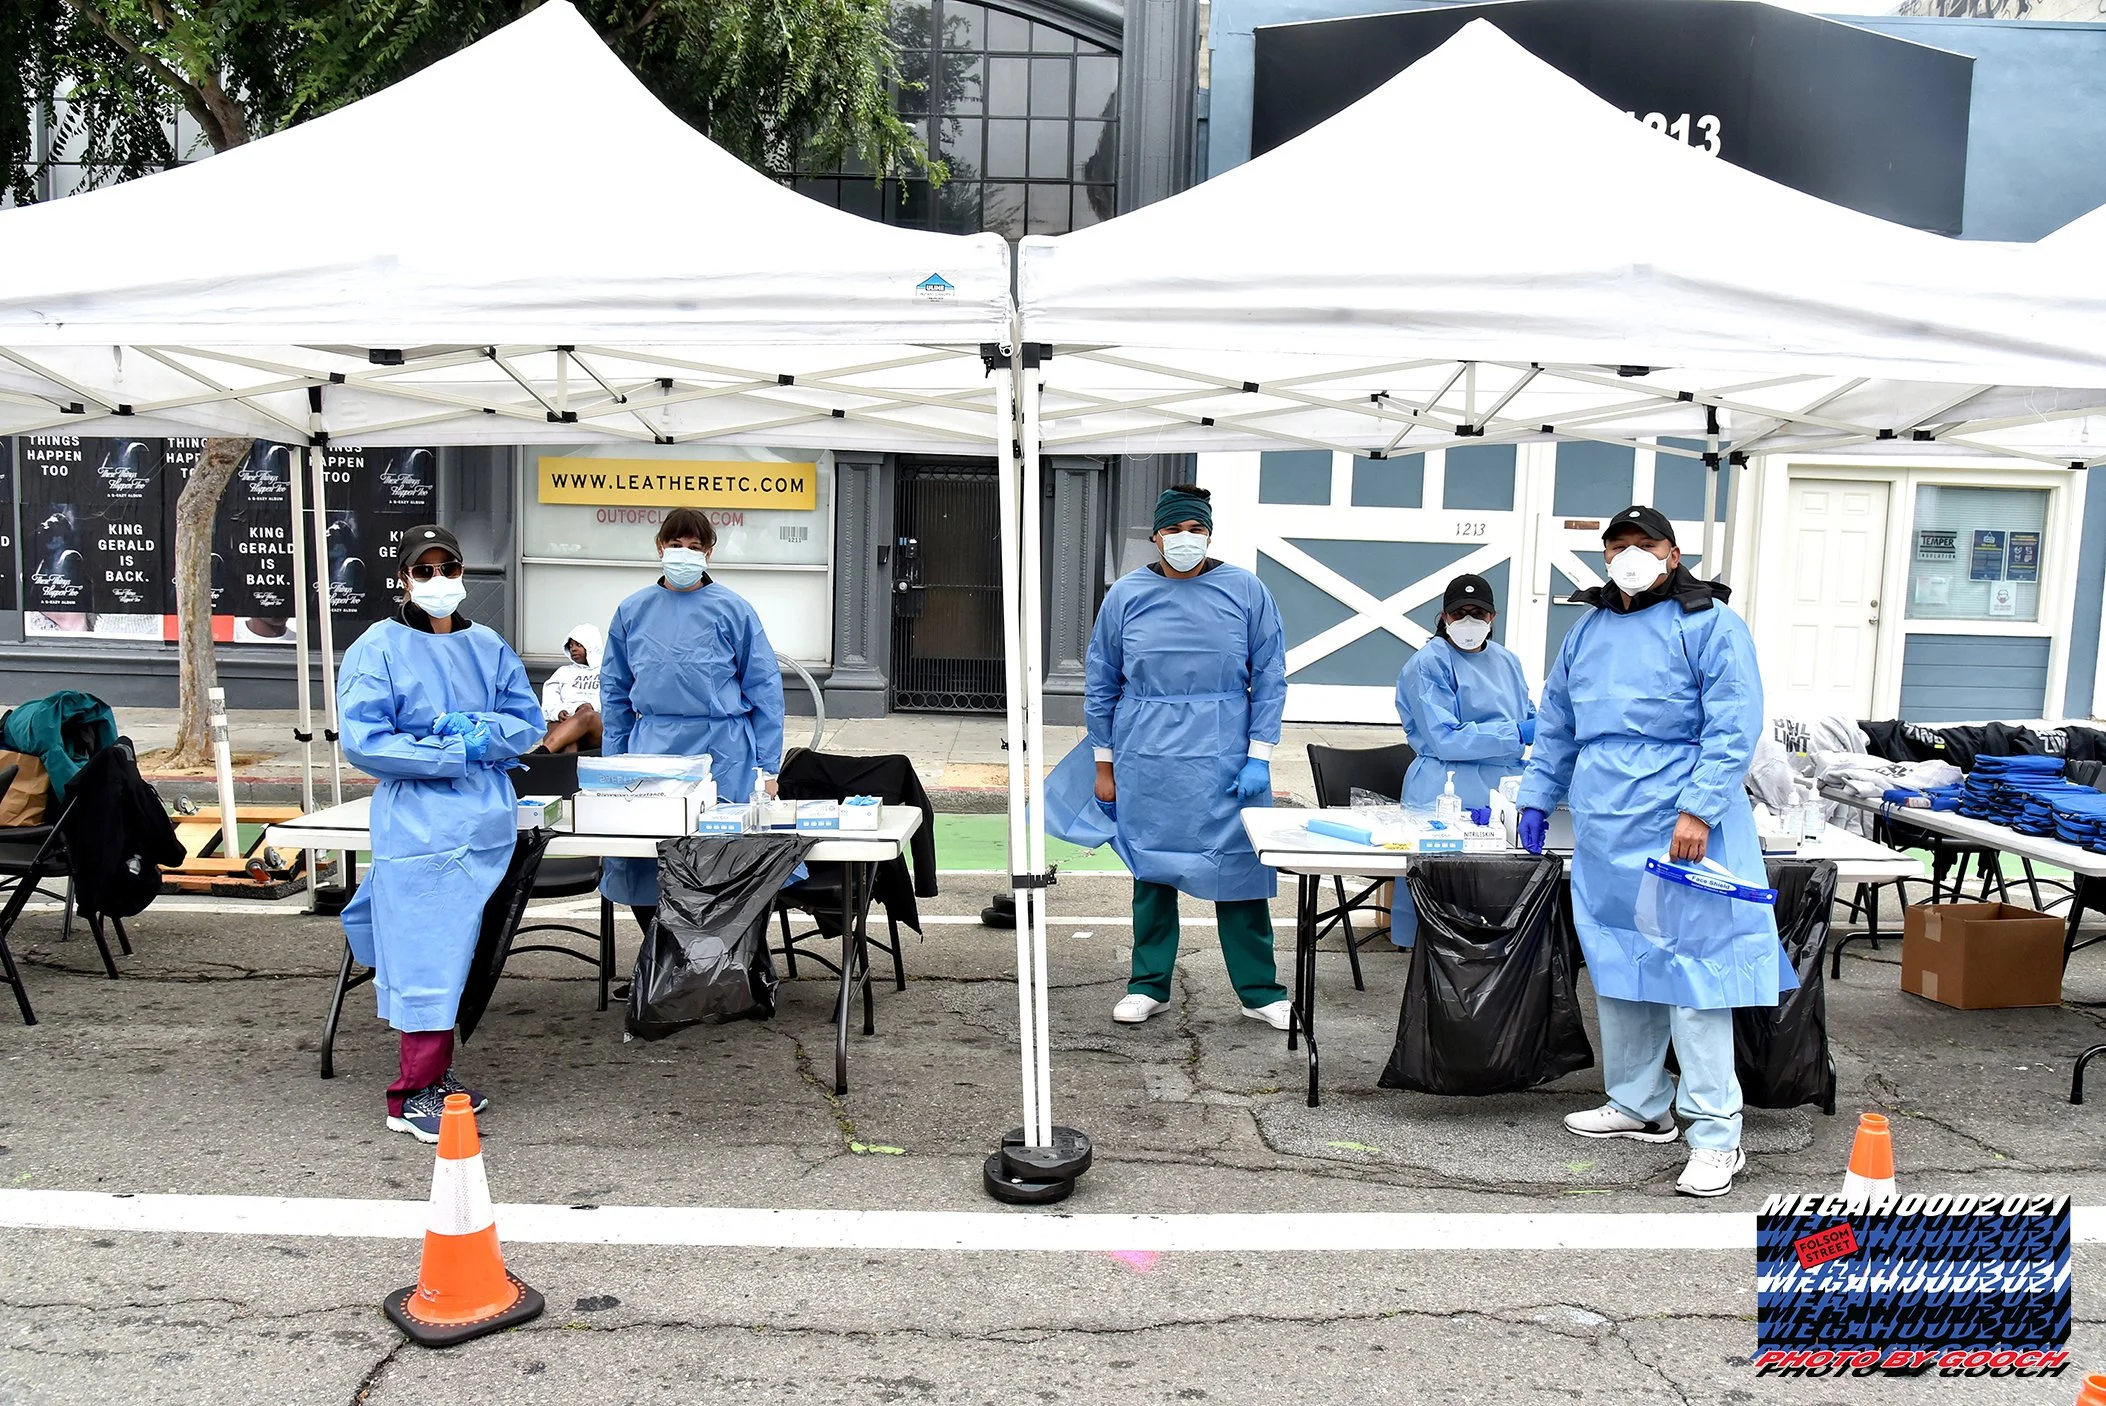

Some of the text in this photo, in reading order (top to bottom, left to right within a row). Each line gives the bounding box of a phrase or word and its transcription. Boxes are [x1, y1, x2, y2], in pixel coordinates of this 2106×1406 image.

[29, 435, 80, 446] THINGS
[168, 437, 208, 448] THING
[27, 450, 82, 462] HAPPEN
[166, 452, 201, 463] HAPP
[41, 465, 69, 477] TOO
[323, 471, 351, 483] TOO
[551, 473, 805, 493] WWW.LEATHERETC.COM
[108, 523, 143, 535] KING
[249, 527, 285, 538] KING
[1456, 522, 1486, 536] 1213
[97, 539, 155, 551] GERALD
[238, 542, 295, 554] GERALD
[1922, 537, 1955, 549] TEMPER
[120, 555, 134, 566] IS
[261, 558, 275, 569] IS
[105, 571, 149, 582] BACK.
[246, 574, 291, 585] BACK.
[1692, 875, 1708, 885] Face
[1708, 879, 1731, 890] Shield
